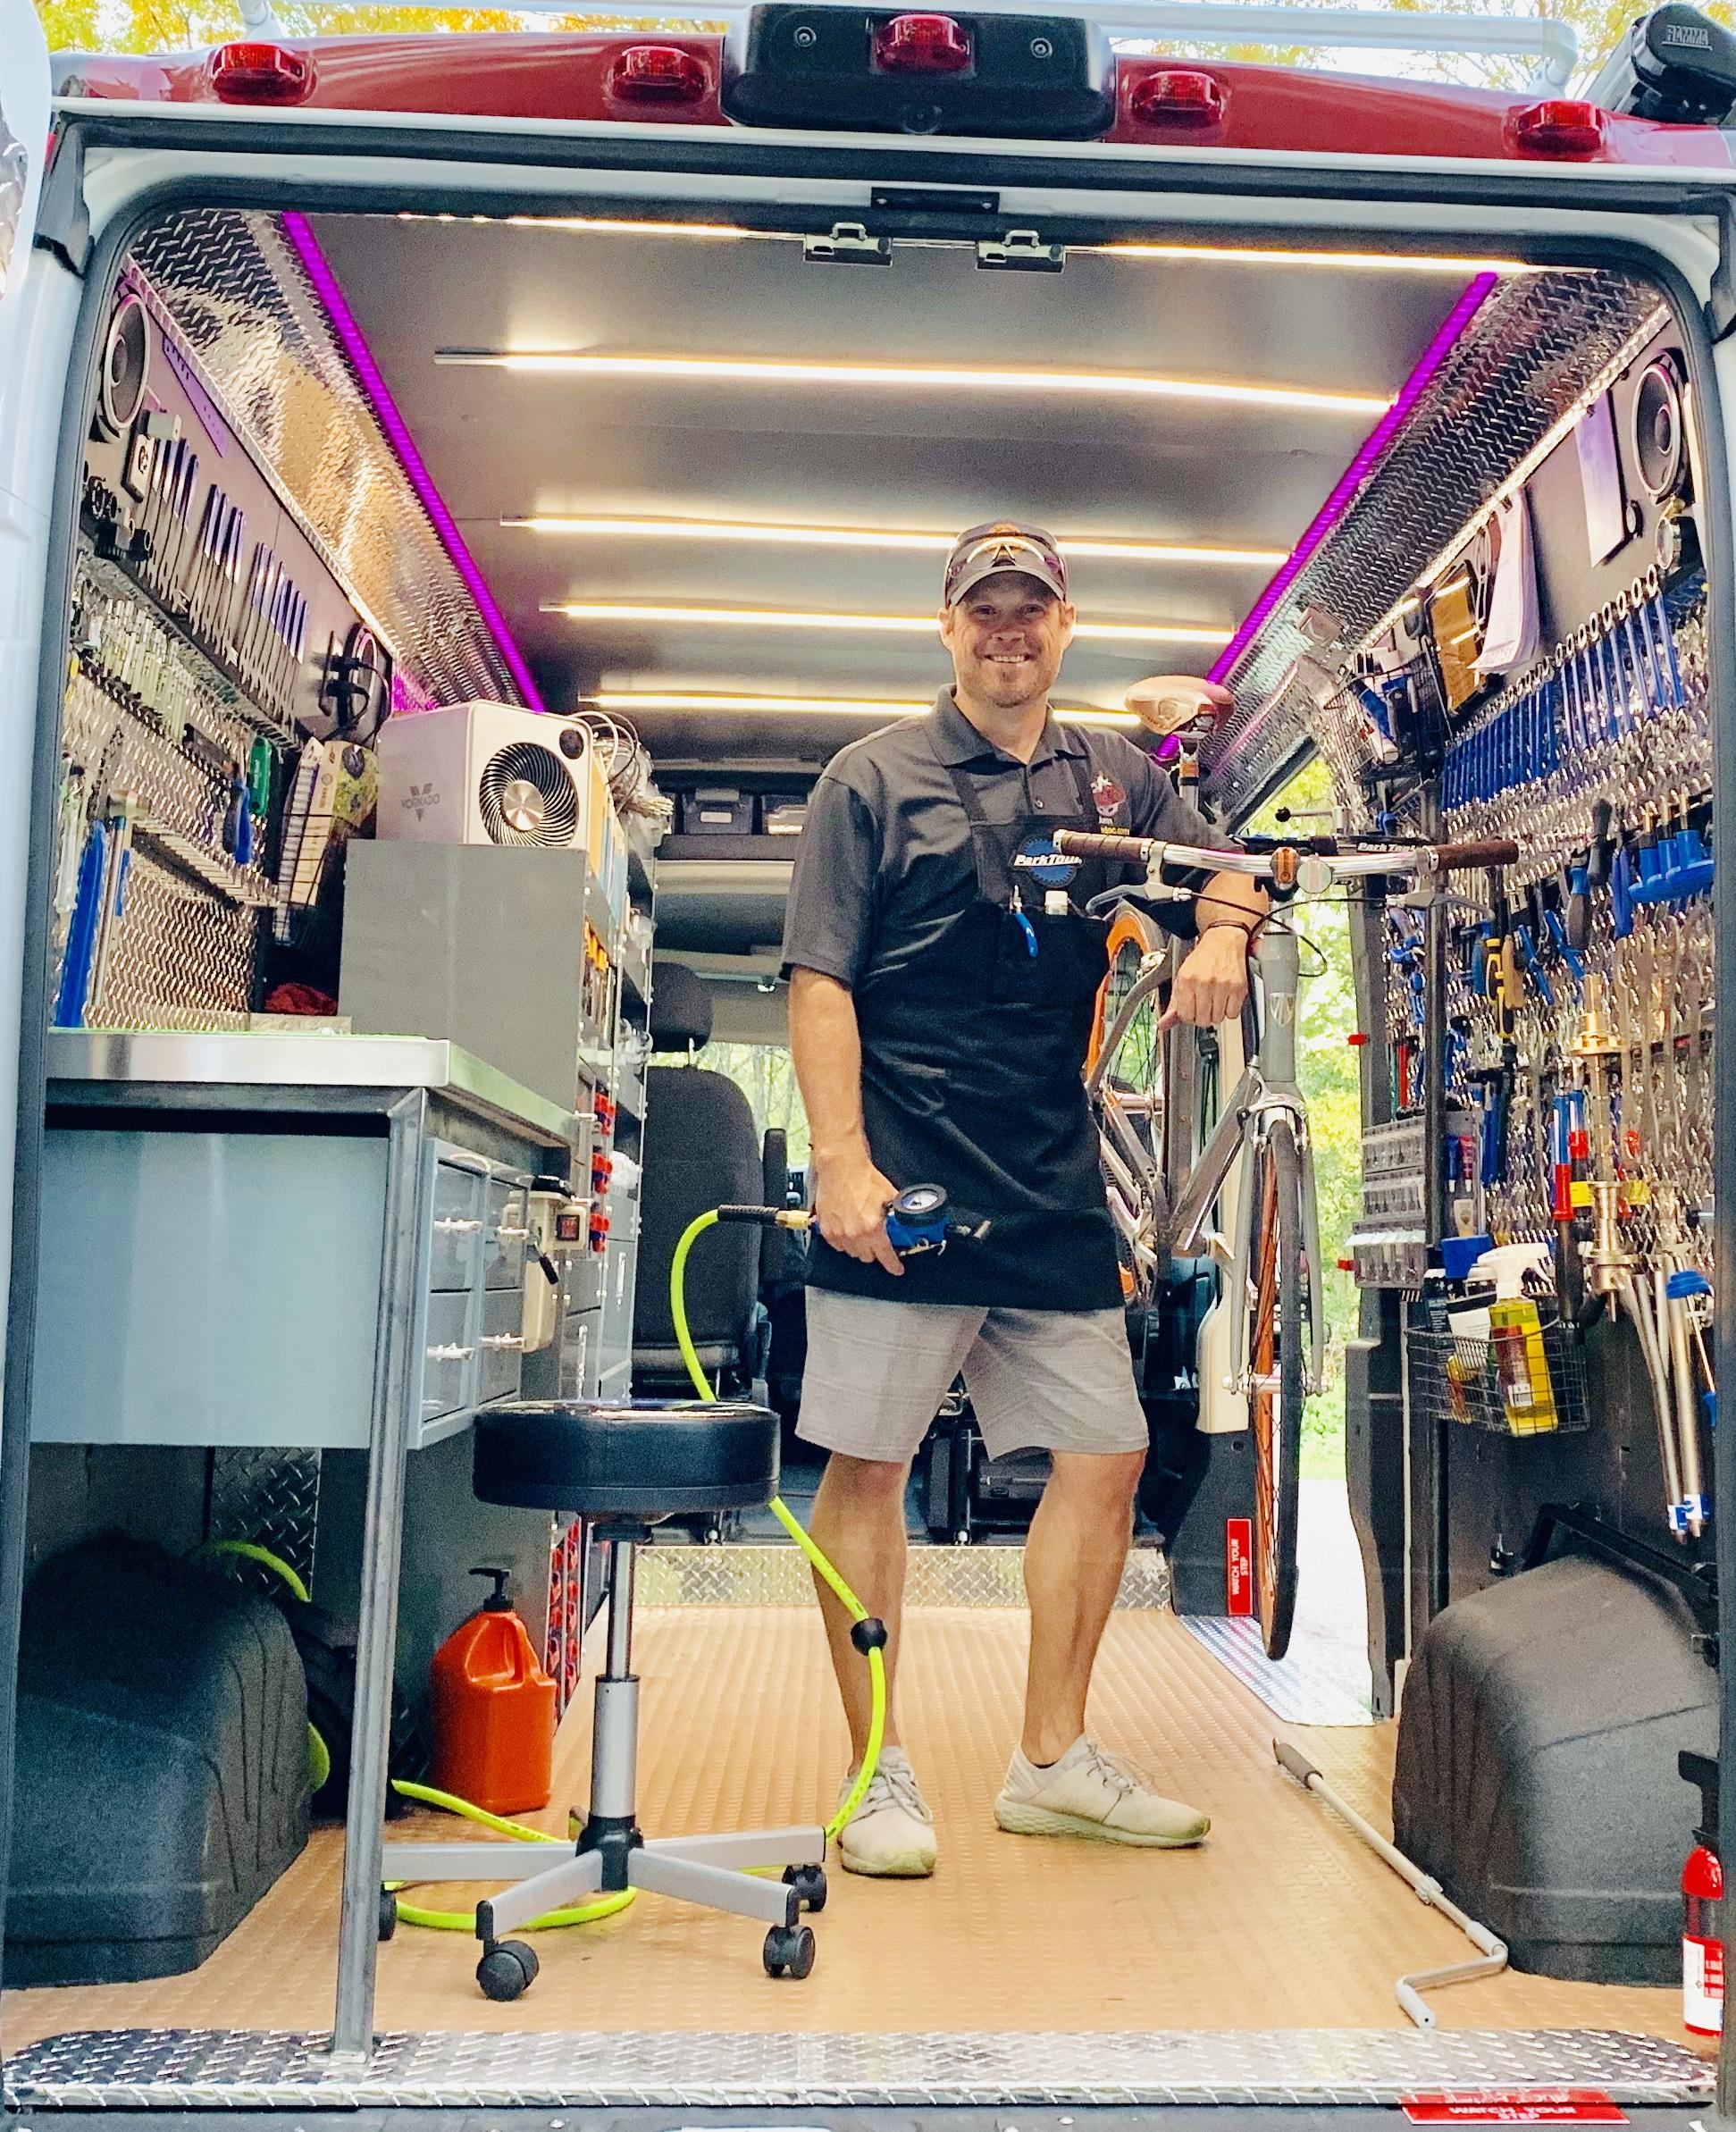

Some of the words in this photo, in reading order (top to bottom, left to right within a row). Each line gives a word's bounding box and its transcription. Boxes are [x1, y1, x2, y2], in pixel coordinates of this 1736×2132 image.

[1357, 842, 1388, 853] Park
[1231, 1538, 1240, 1563] YOUR
[1239, 1556, 1249, 1576] STEP
[1231, 1565, 1240, 1596] WATCH
[1448, 2106, 1515, 2115] WATCH
[1522, 2106, 1577, 2115] YOUR
[1497, 2112, 1540, 2120] STEP
